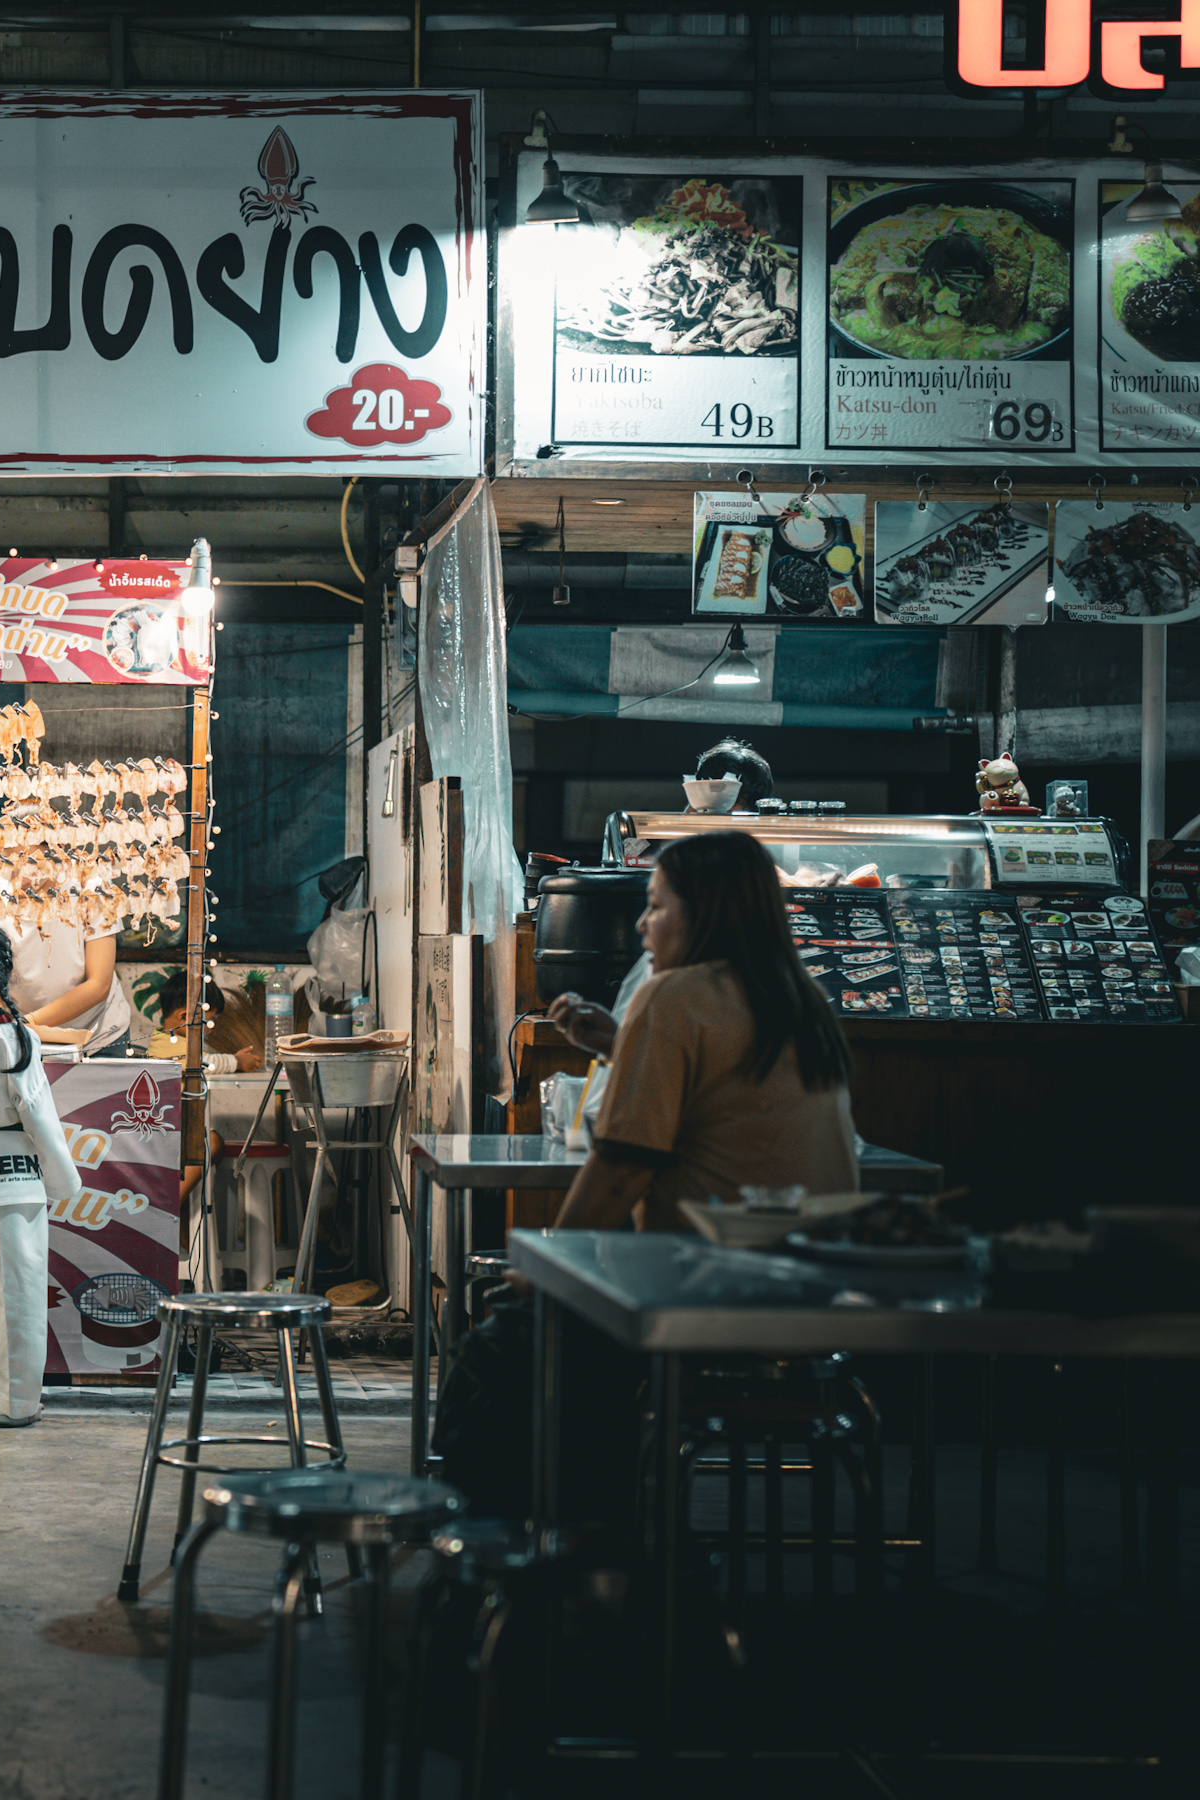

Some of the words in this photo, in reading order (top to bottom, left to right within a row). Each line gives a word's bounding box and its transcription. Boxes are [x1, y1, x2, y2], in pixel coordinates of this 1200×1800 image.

[352, 388, 430, 431] 20.-
[836, 395, 936, 414] Katsu-don
[1111, 403, 1181, 416] Katsu/Fried
[836, 423, 888, 441] カツ丼
[109, 573, 171, 588] น้ำจิ้มรสเด็ด
[892, 614, 921, 623] Wagyu
[1069, 613, 1097, 622] Wagyu
